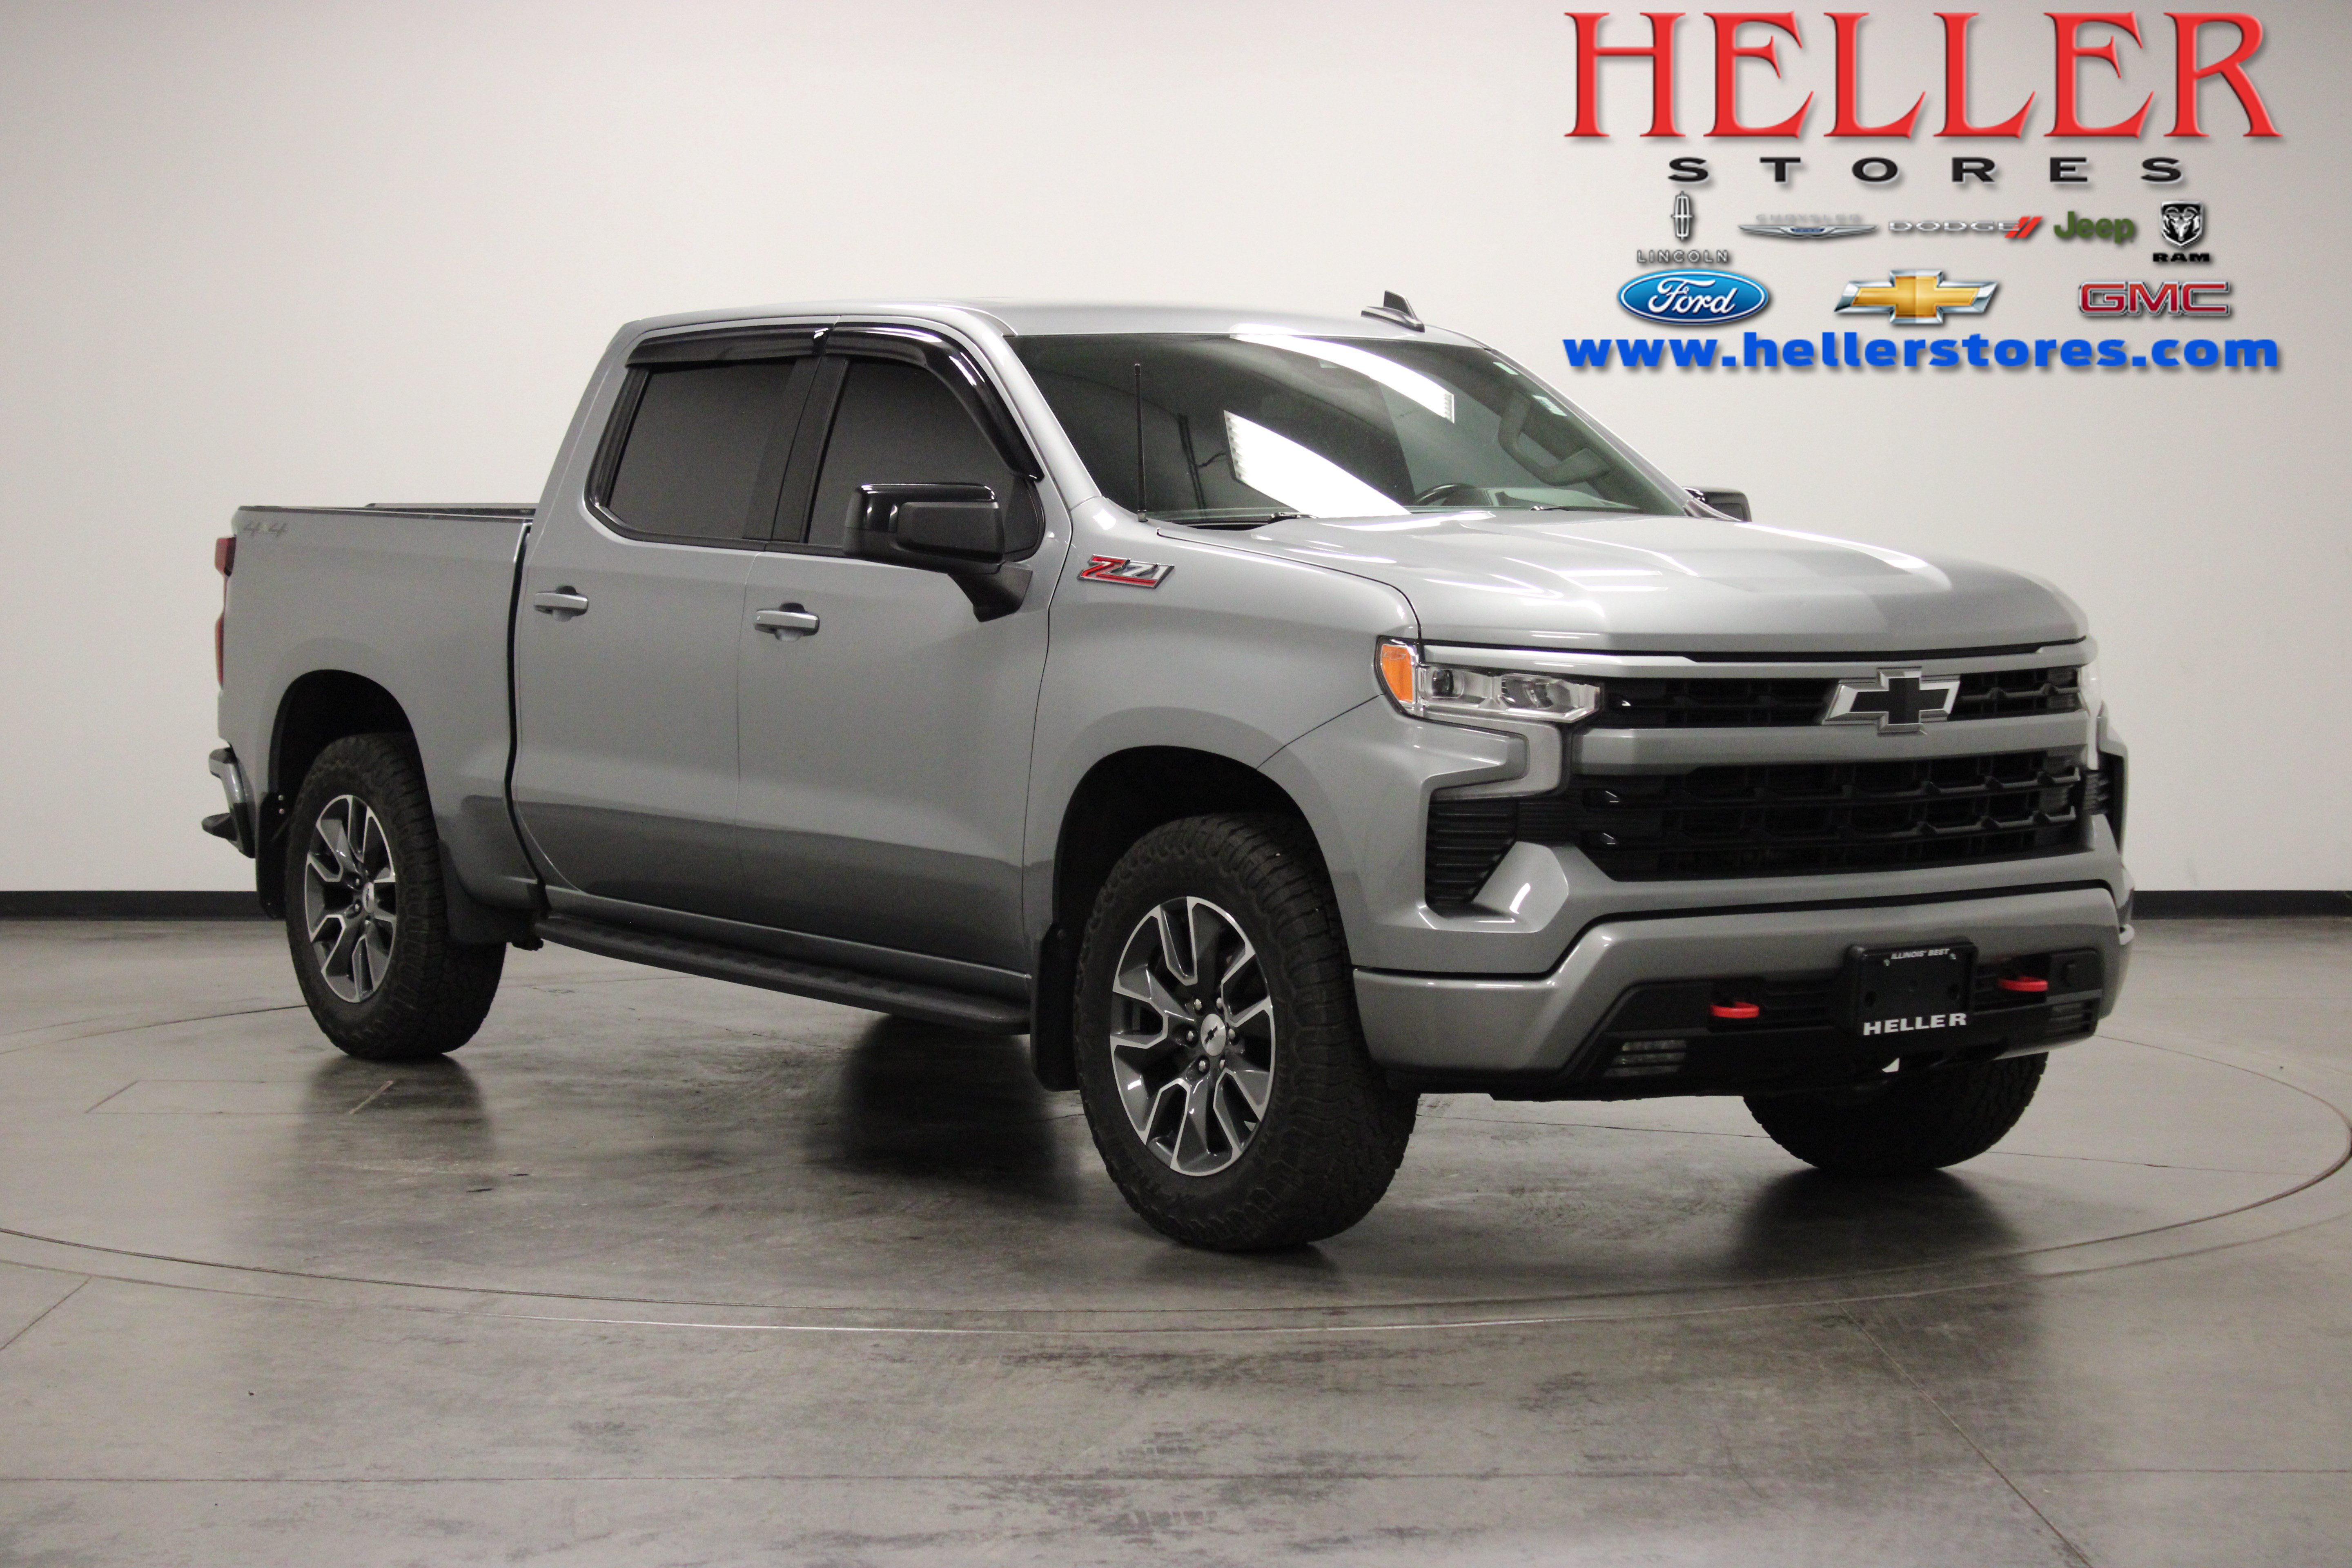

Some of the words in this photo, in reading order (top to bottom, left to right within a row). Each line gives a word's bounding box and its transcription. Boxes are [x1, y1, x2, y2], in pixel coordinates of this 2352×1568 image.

[243, 521, 288, 538] 44
[1077, 553, 1175, 588] Z71
[1927, 948, 1950, 956] BEST
[1863, 1013, 1966, 1036] HELLER
